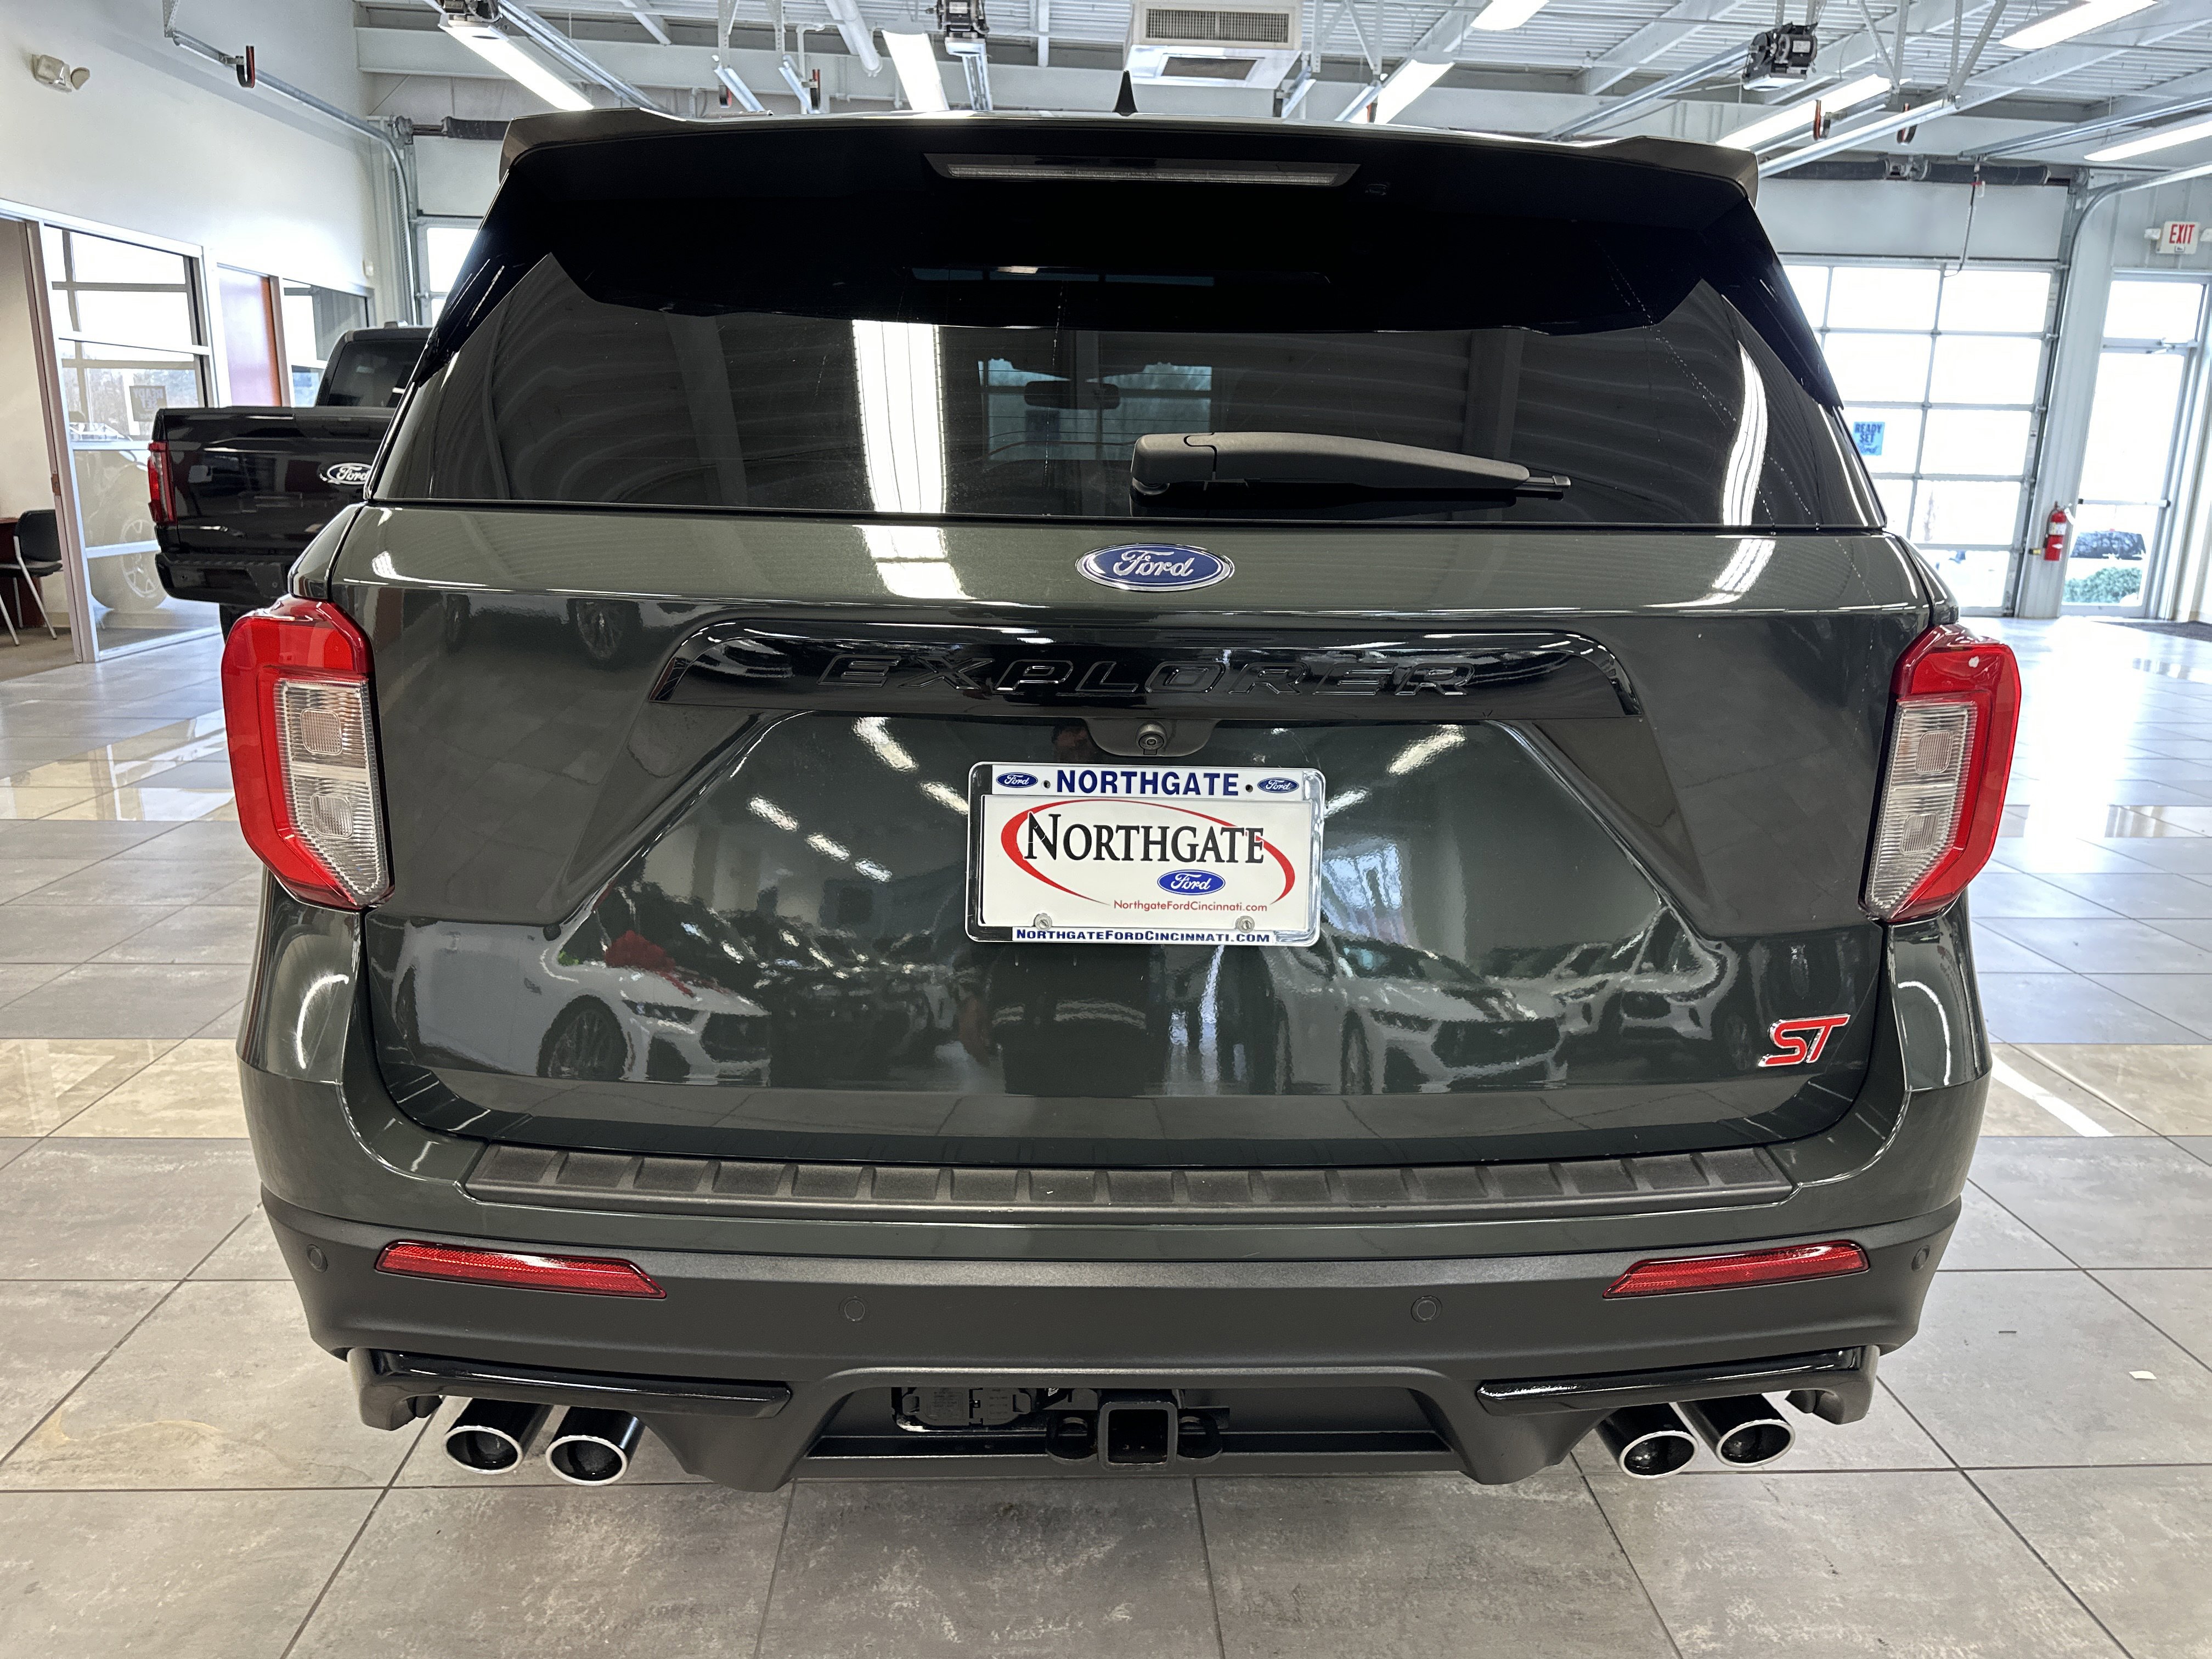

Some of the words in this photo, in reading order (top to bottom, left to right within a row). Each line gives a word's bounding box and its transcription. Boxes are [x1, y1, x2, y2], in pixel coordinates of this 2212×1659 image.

[2169, 224, 2195, 244] EXIT
[1855, 424, 1882, 433] READY
[1859, 432, 1874, 443] SET
[1113, 550, 1195, 577] Ford
[816, 654, 1475, 696] EXPLORER
[1003, 774, 1029, 785] Ford
[1057, 770, 1239, 796] NORTHGATE
[1265, 779, 1290, 790] Ford
[1024, 812, 1264, 864] NORTHGATE
[1170, 873, 1211, 890] Ford
[1113, 900, 1268, 912] NorthgateFordCincinnati.com
[1757, 1013, 1851, 1068] ST
